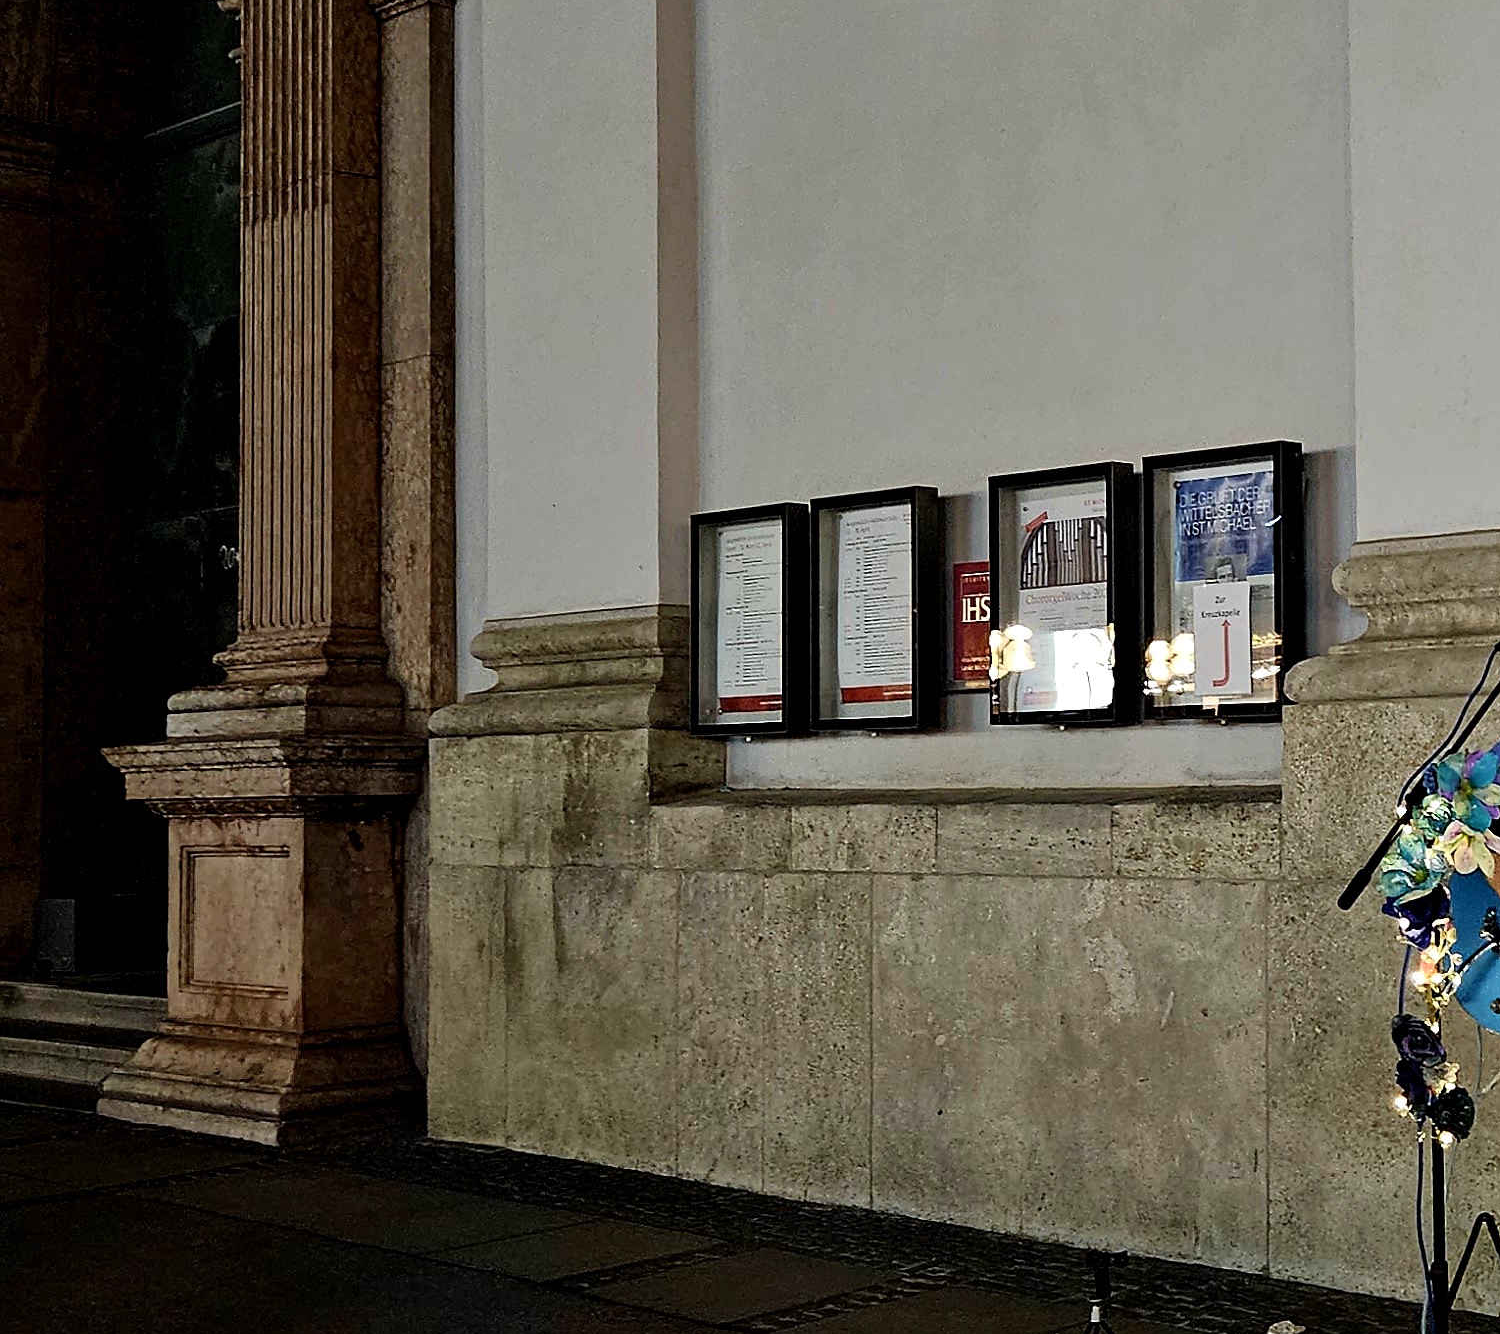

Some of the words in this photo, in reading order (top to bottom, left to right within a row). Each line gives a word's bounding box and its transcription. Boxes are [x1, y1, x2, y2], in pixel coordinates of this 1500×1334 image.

[1180, 499, 1271, 522] WITTELSBACHER
[1215, 595, 1226, 604] Zur
[962, 596, 990, 623] IHS
[1201, 607, 1241, 619] Kreuzkapelle
